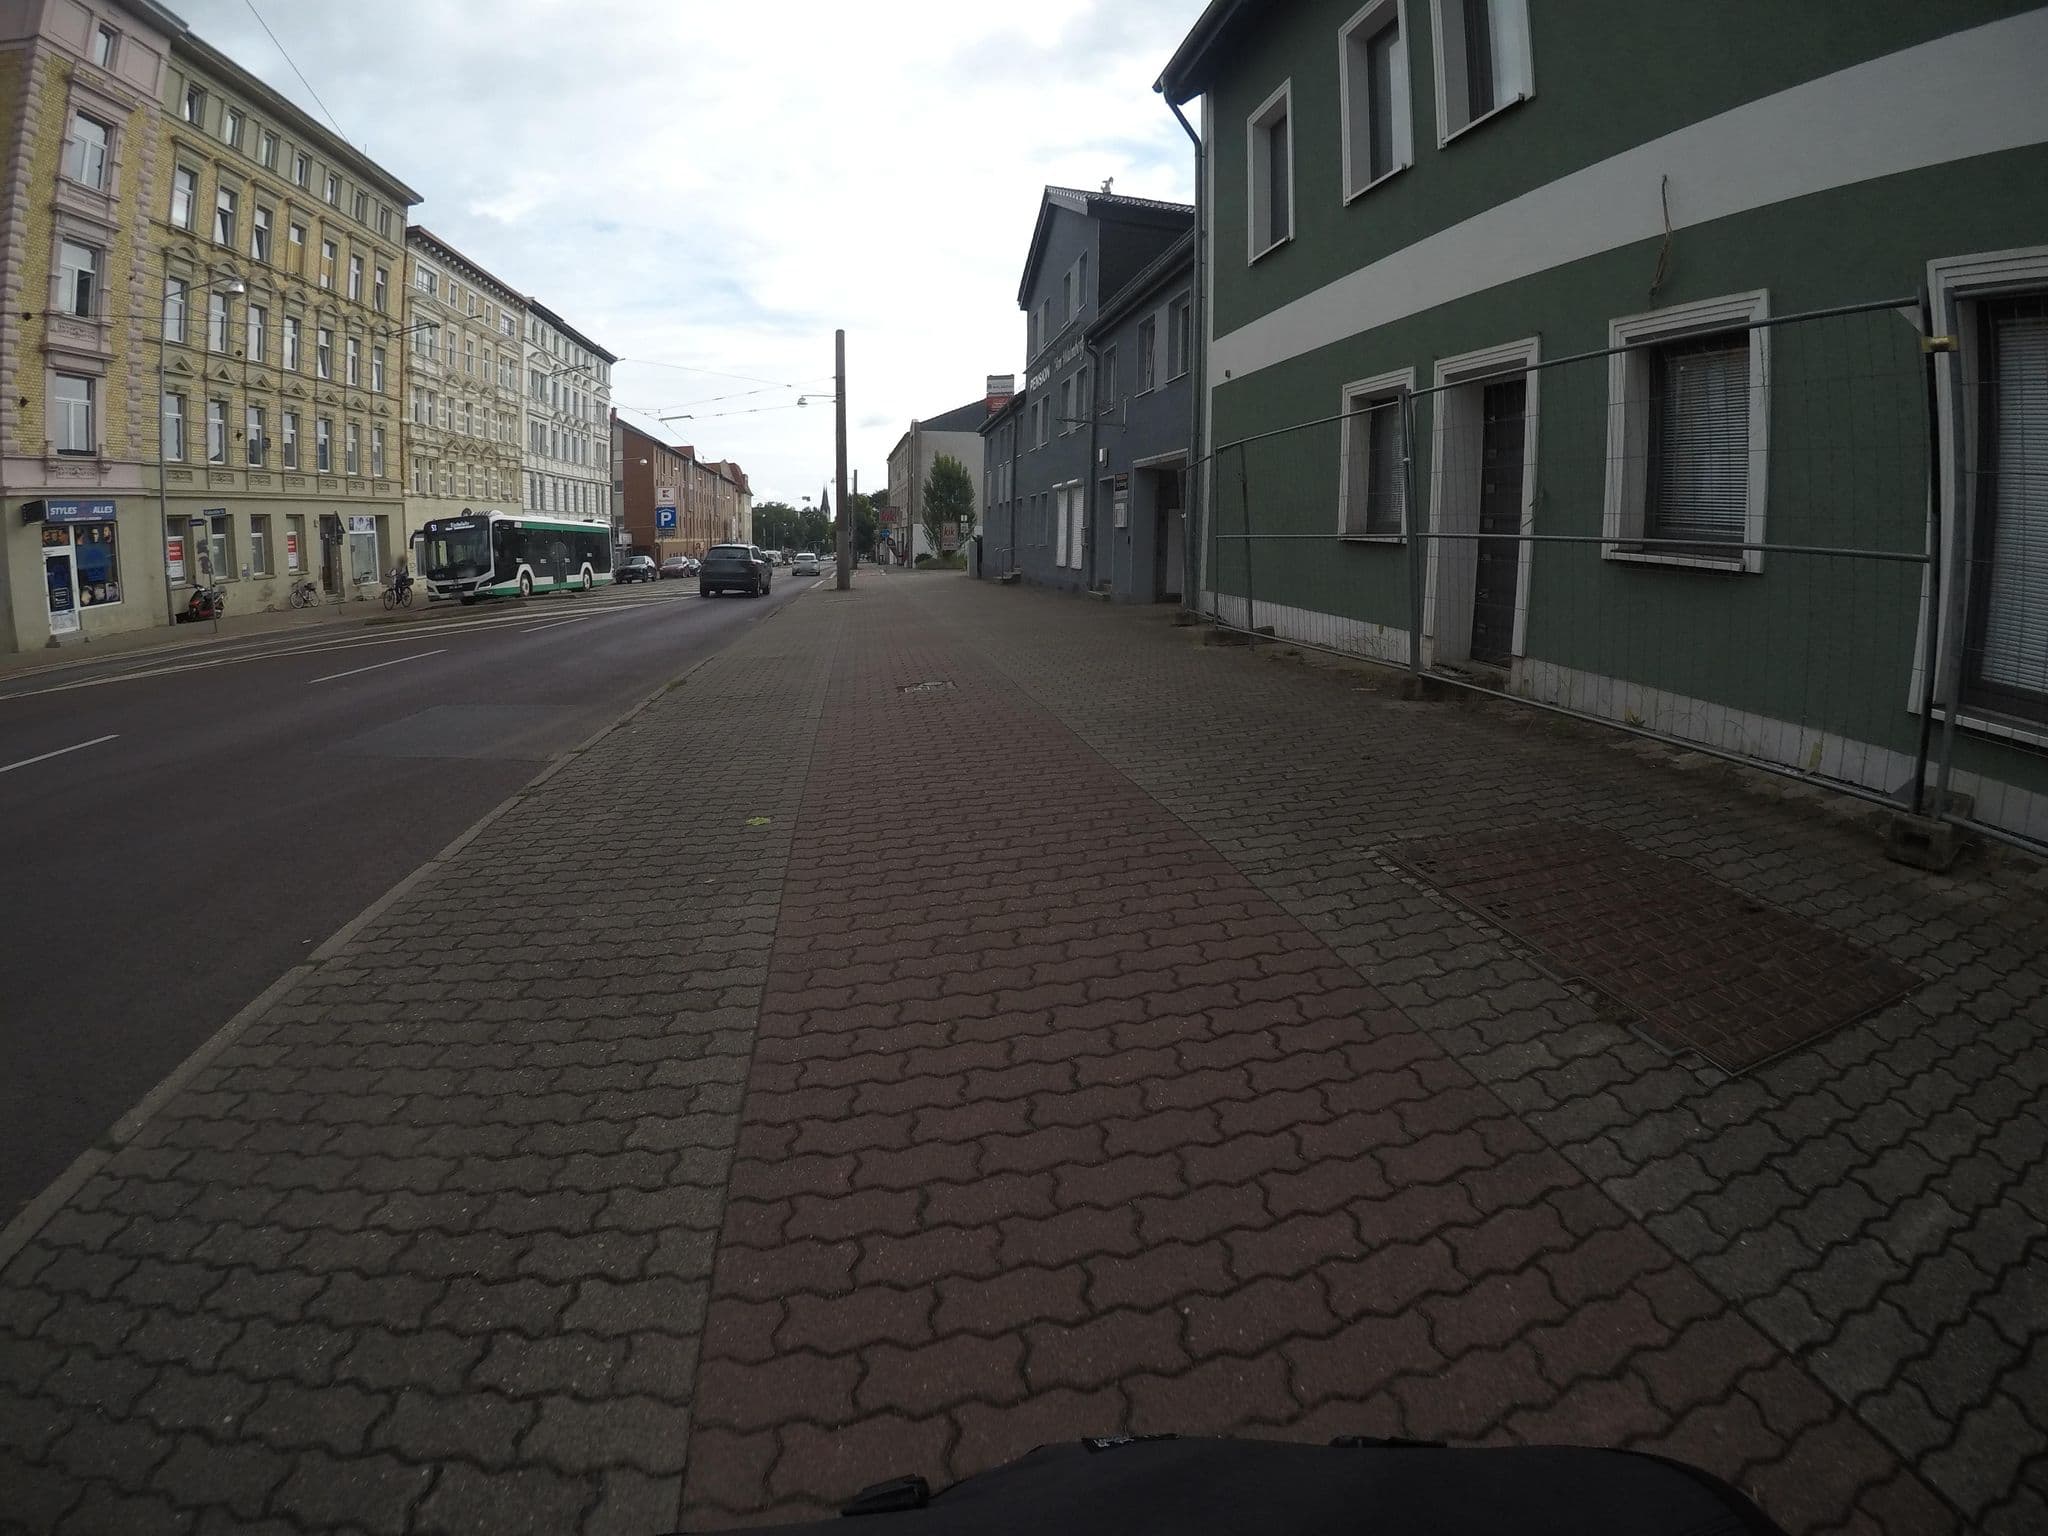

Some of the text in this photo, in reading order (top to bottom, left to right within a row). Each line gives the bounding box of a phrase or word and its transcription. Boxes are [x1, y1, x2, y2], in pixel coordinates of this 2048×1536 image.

[50, 505, 114, 516] STYLES ALLES
[660, 512, 672, 526] P
